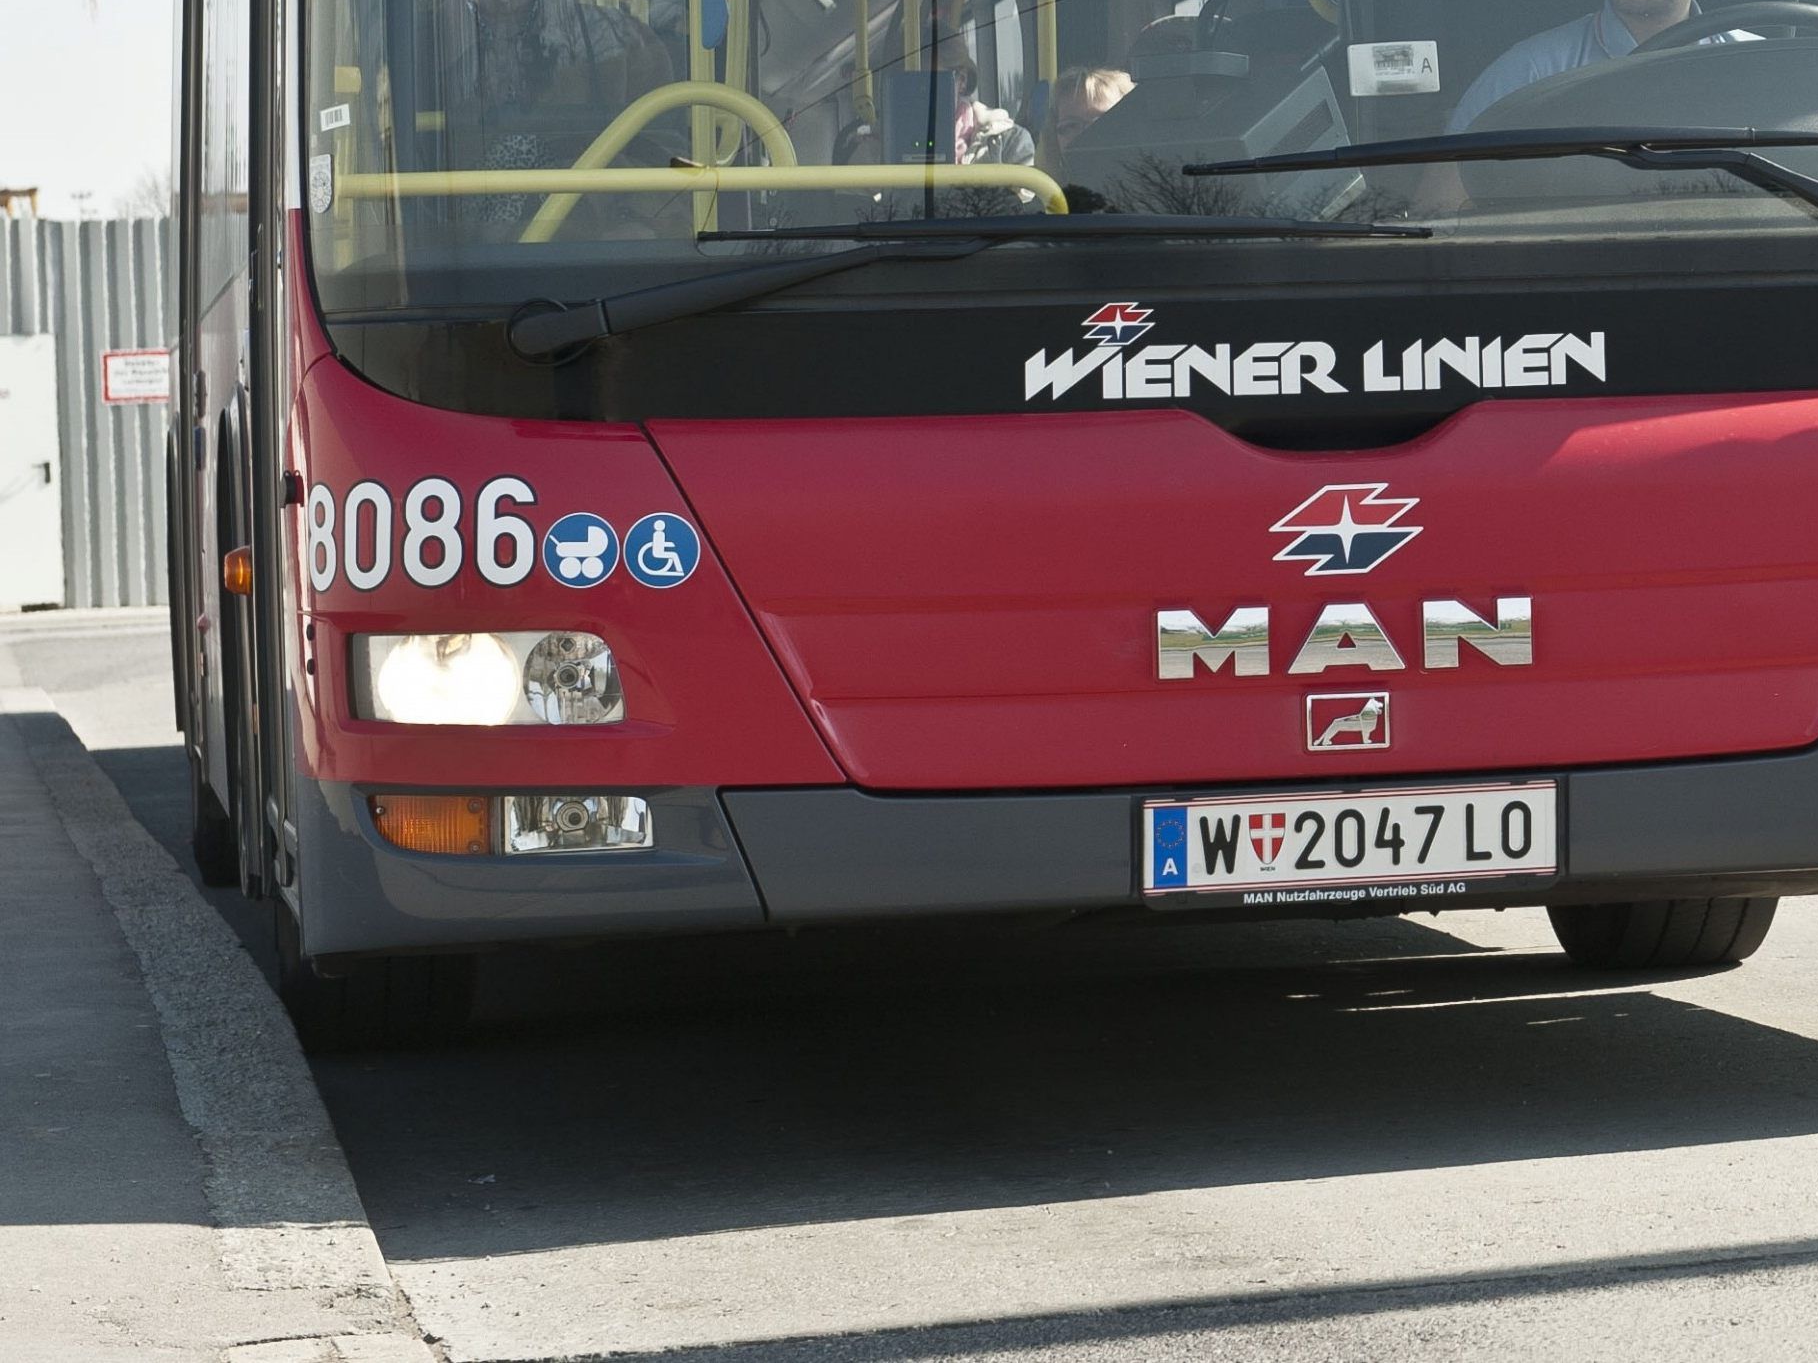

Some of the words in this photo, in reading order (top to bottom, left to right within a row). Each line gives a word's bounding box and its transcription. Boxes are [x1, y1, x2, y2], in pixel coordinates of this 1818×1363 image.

[1025, 341, 1349, 401] WIENER
[1363, 331, 1606, 392] LINIEN
[308, 474, 538, 592] 8086
[1155, 595, 1535, 680] MAN
[1162, 858, 1179, 876] A
[1199, 814, 1241, 876] W
[1243, 891, 1273, 905] MAN
[1276, 887, 1366, 904] Nutzfahrzeuge
[1369, 884, 1418, 898] Vertrieb
[1420, 881, 1445, 896] Süd
[1447, 882, 1467, 894] AG
